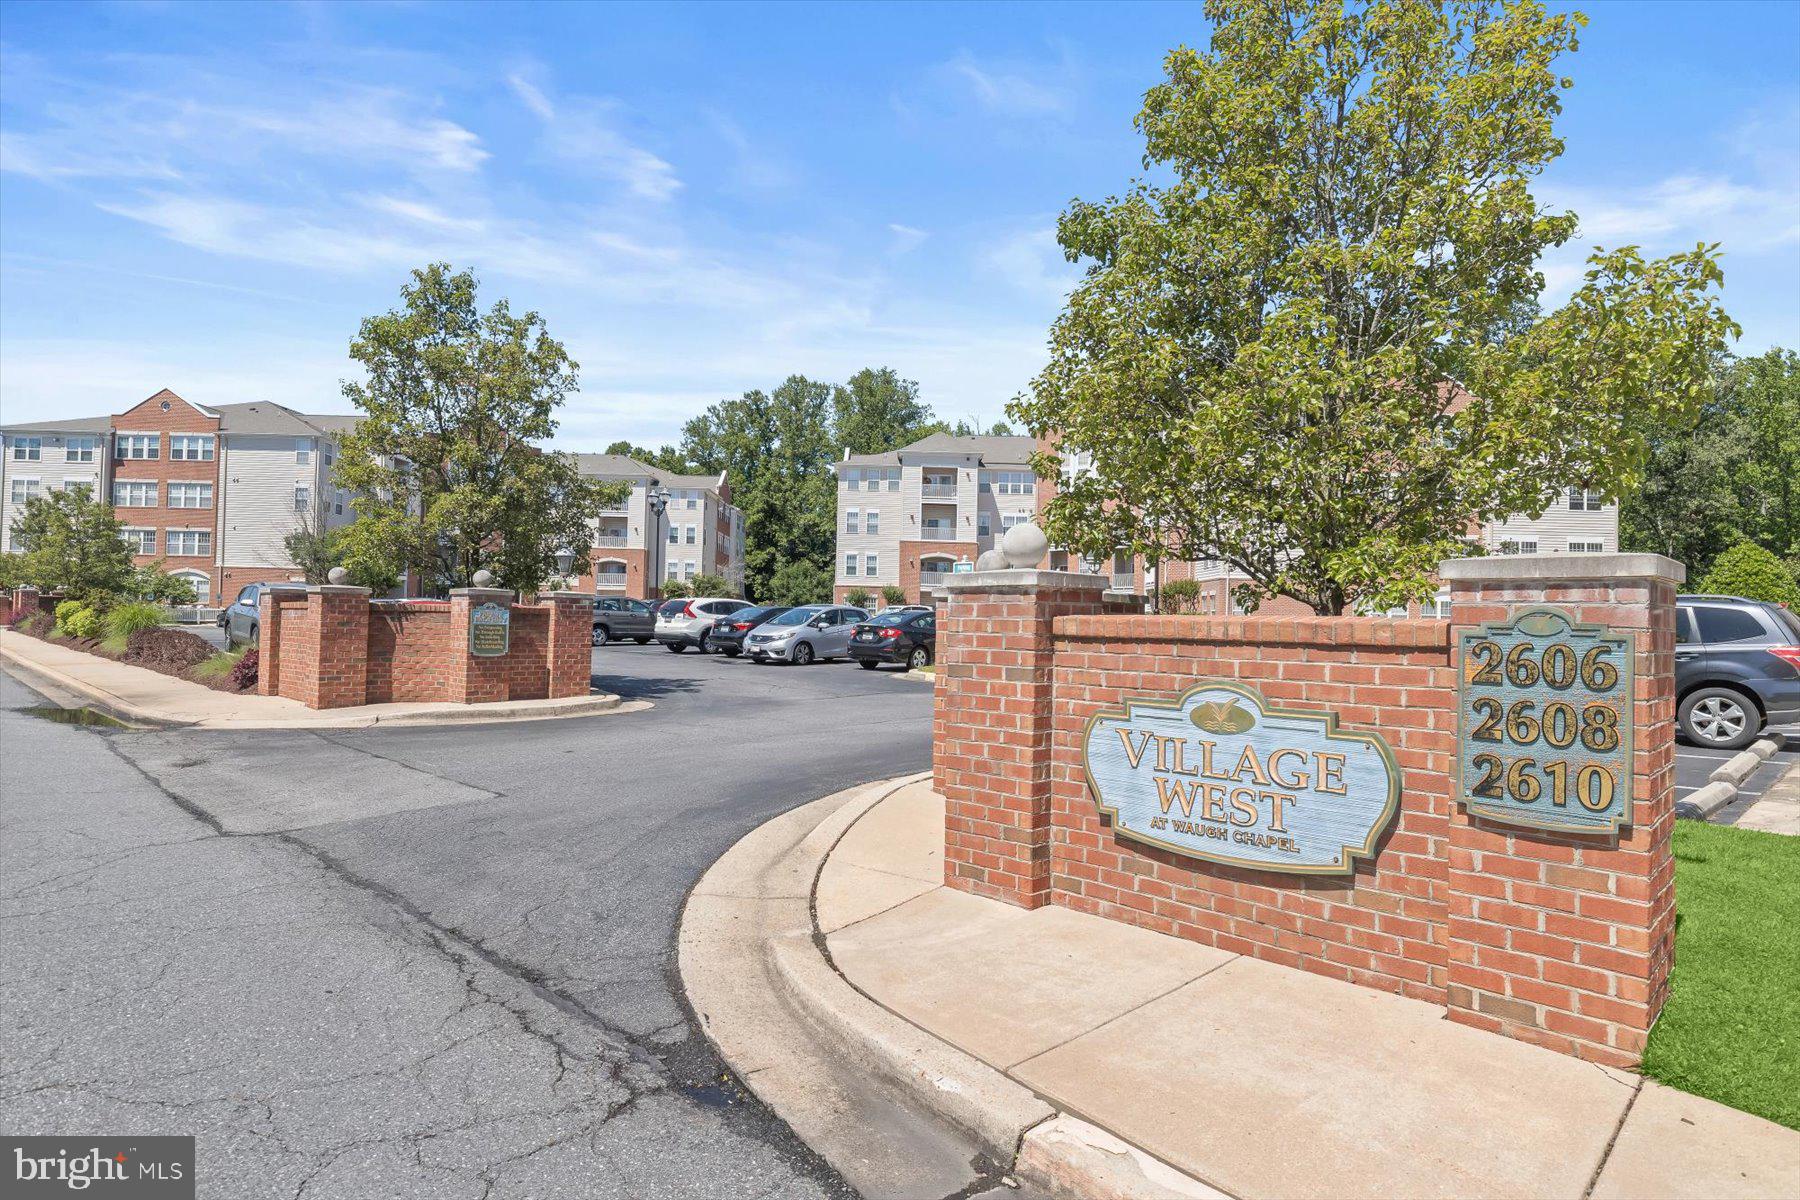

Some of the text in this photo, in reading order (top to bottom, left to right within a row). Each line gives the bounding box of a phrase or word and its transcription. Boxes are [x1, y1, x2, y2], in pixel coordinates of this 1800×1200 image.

[1471, 640, 1618, 692] 2606
[1471, 697, 1619, 753] 2608
[1114, 727, 1348, 796] VILLAGE
[1472, 753, 1615, 813] 2610
[1152, 775, 1296, 833] WEST
[1150, 816, 1301, 853] AT WAUGH CHAPEL
